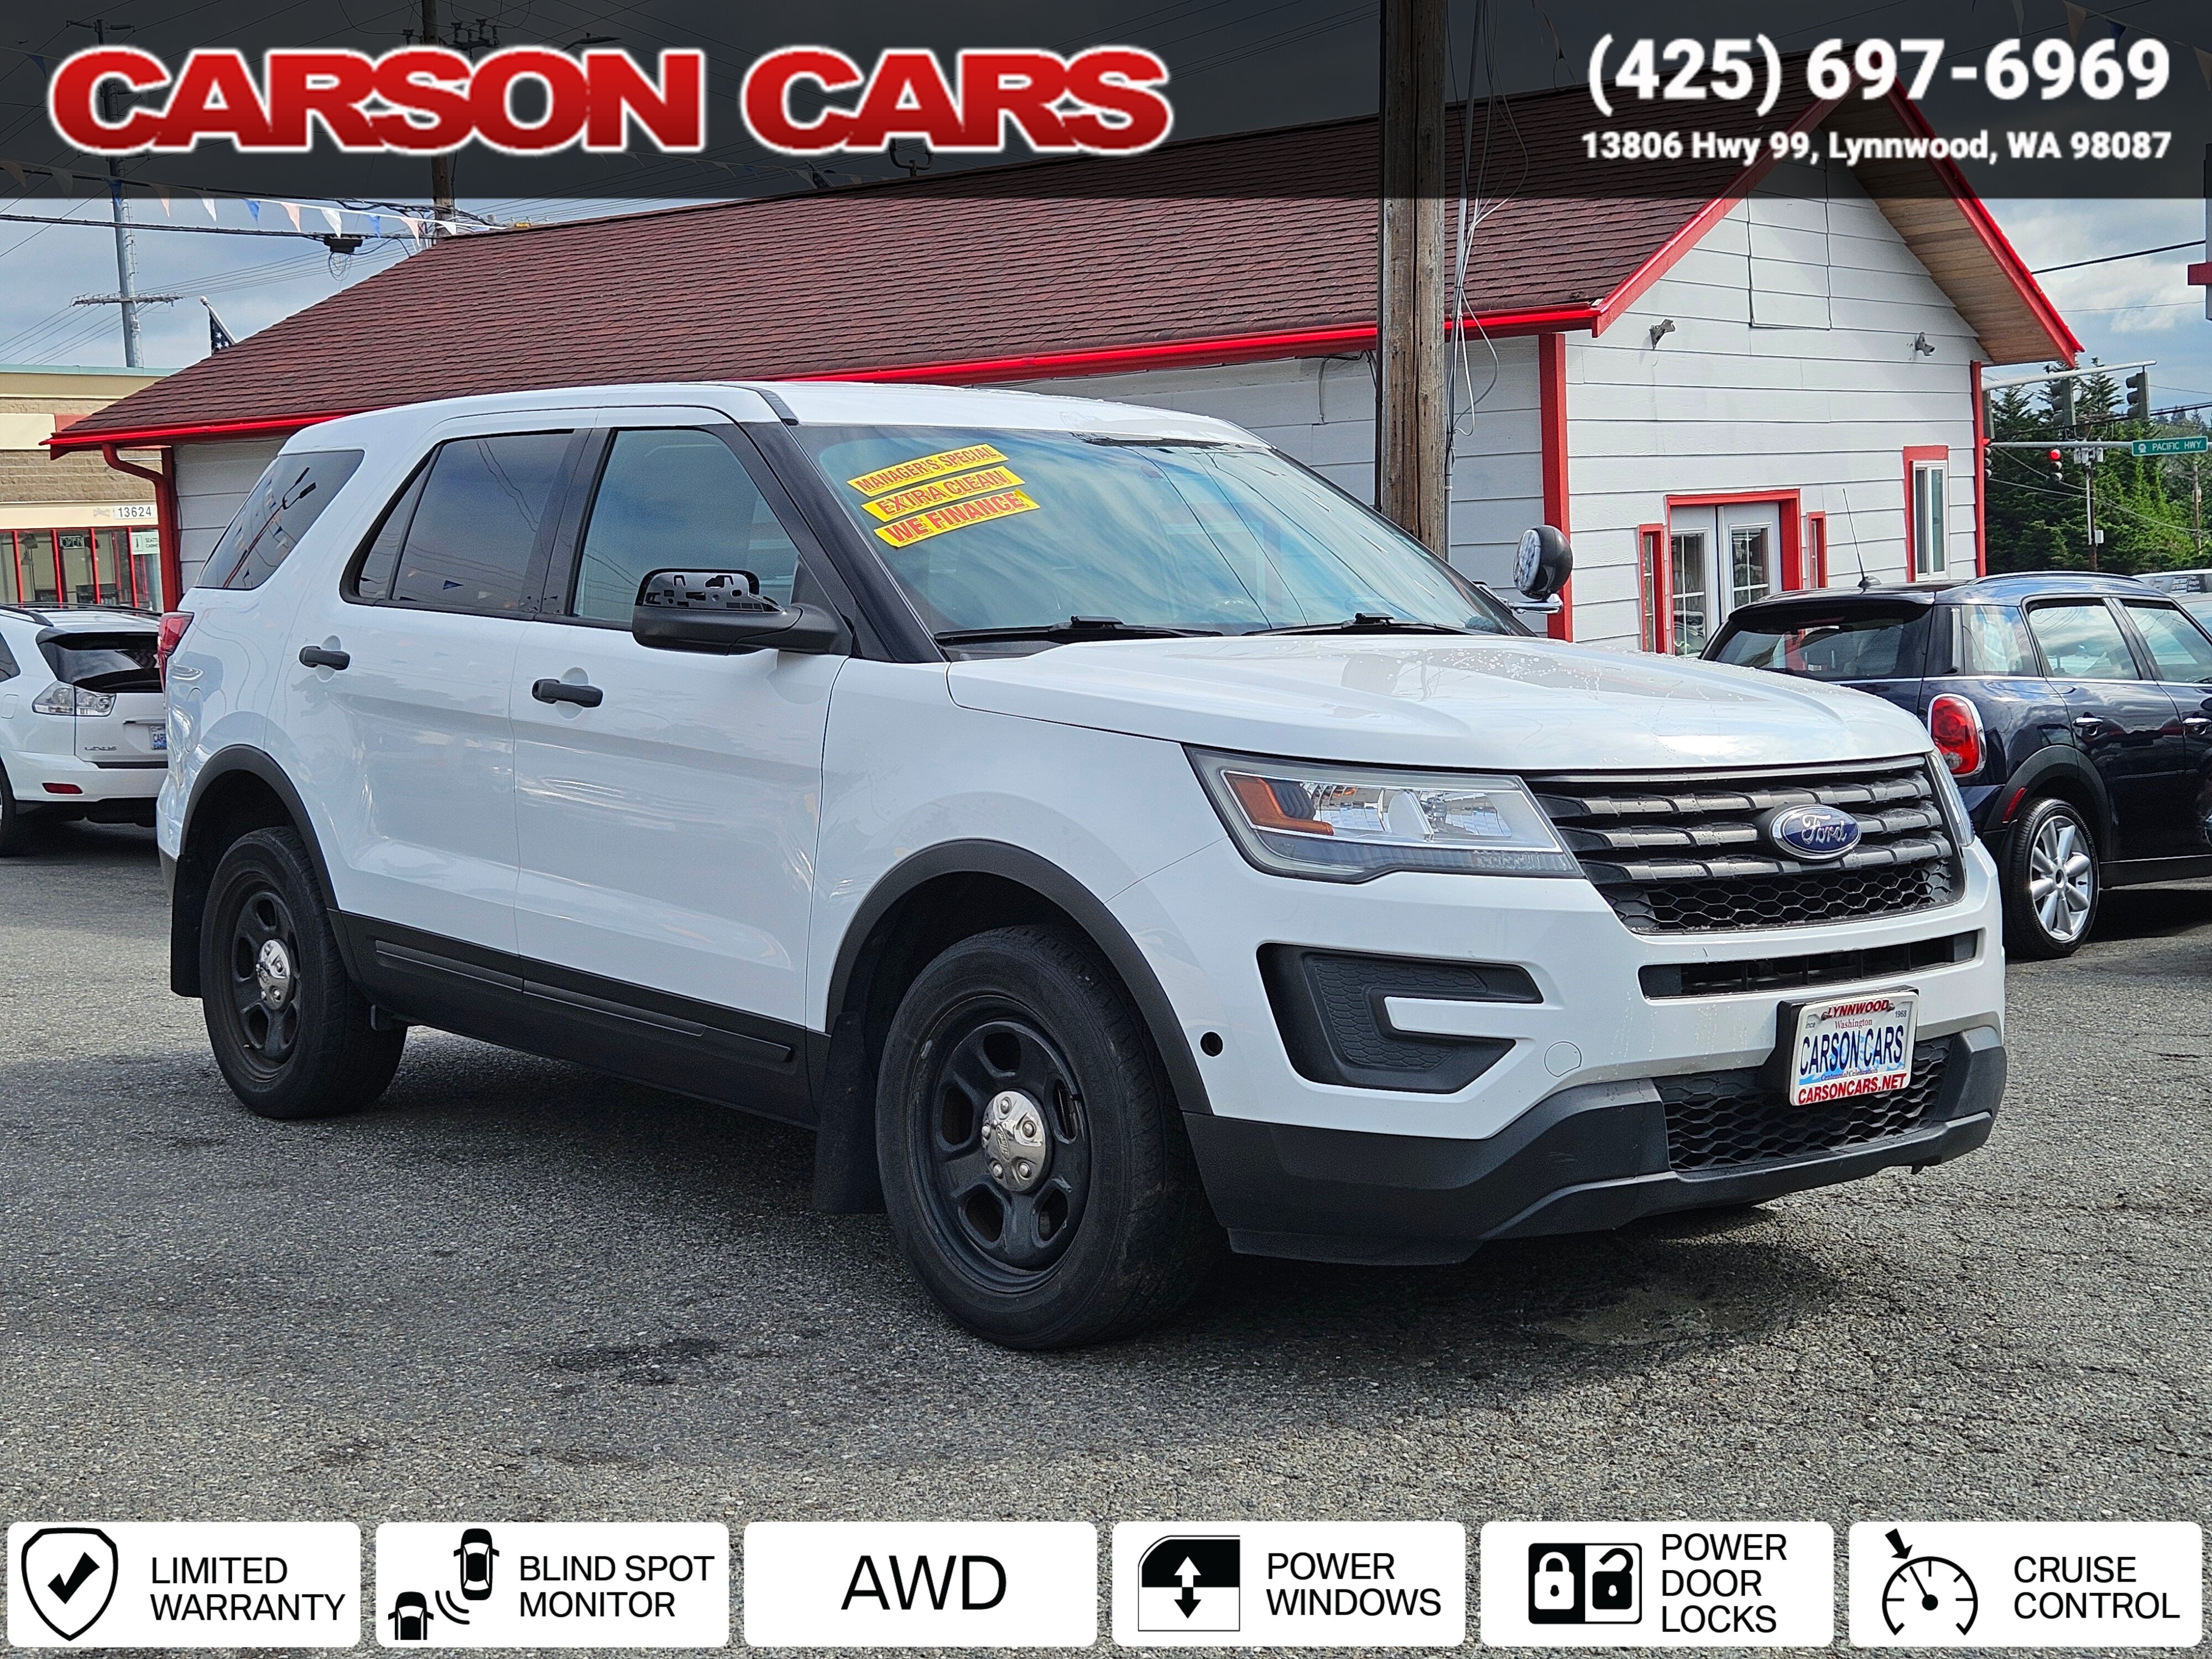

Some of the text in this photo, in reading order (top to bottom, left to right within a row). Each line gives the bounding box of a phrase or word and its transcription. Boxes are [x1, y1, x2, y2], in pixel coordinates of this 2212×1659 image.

[2152, 442, 2180, 451] PACIFIC
[855, 446, 1000, 493] MANAGER'S SPECIAL
[875, 469, 1010, 515] EXTRA CLEAN
[118, 506, 152, 518] 13624
[885, 492, 1026, 542] WE FINANCE
[62, 537, 84, 547] OPEN
[1801, 815, 1848, 845] Ford
[1827, 999, 1890, 1019] LYNNWOOD
[1834, 1018, 1873, 1030] Washington
[1799, 1025, 1904, 1076] CARSON CARS
[1798, 1073, 1907, 1104] CARSONCARS.NET
